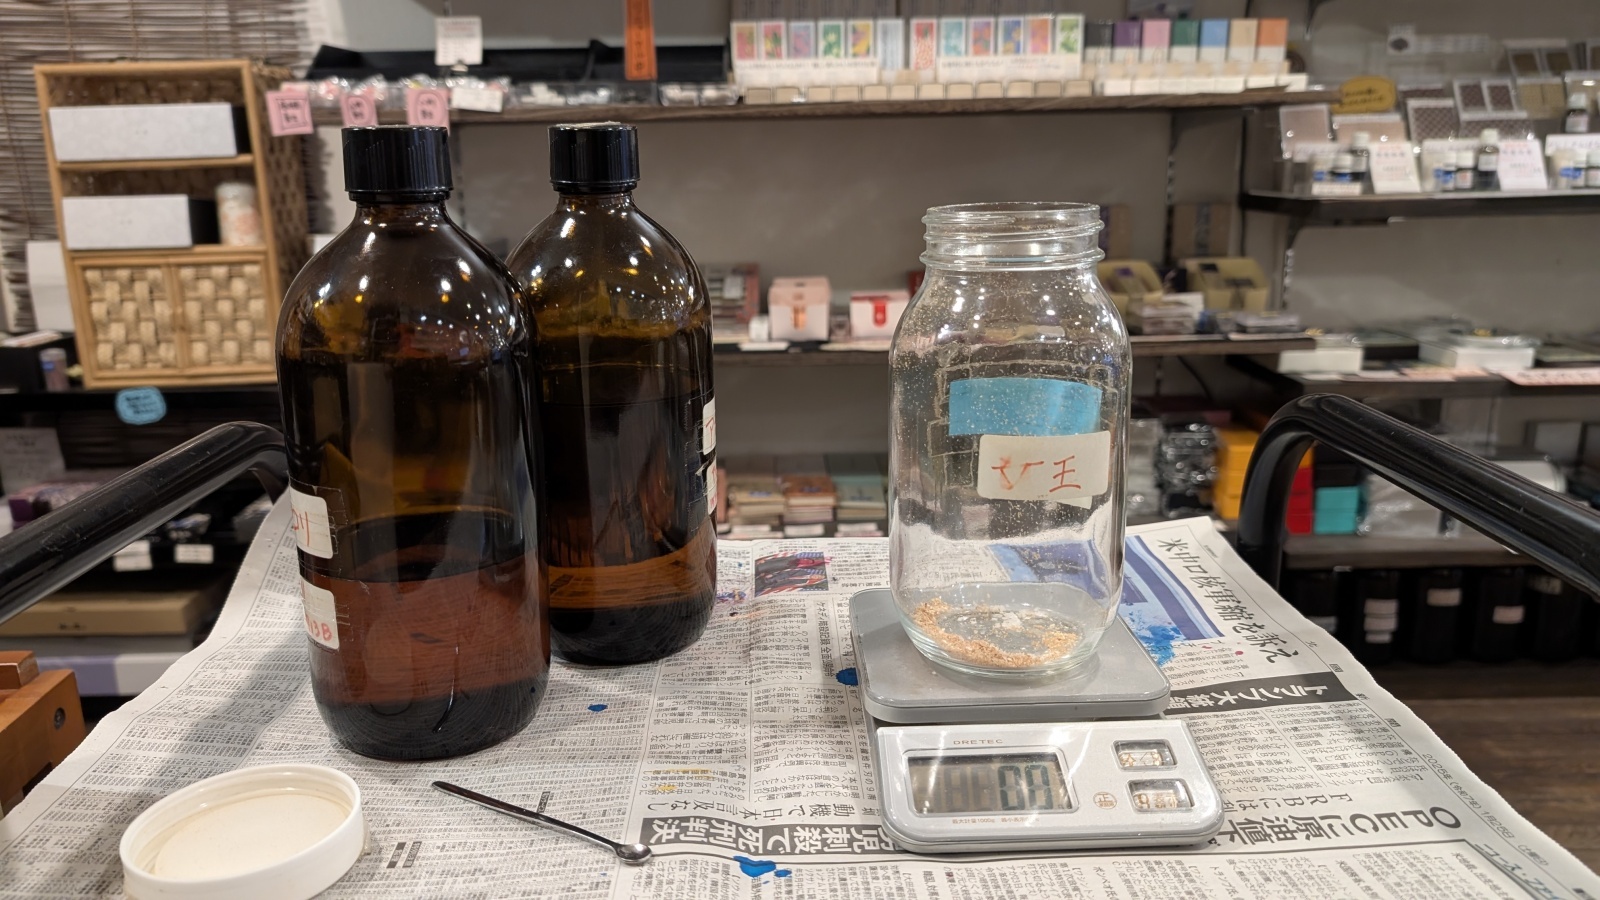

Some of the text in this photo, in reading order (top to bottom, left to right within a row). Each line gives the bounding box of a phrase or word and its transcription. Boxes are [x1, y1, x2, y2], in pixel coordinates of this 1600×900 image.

[1152, 538, 1297, 663] 米中ロ核軍縮を訴え
[647, 800, 855, 820] 動機で日本言及なし
